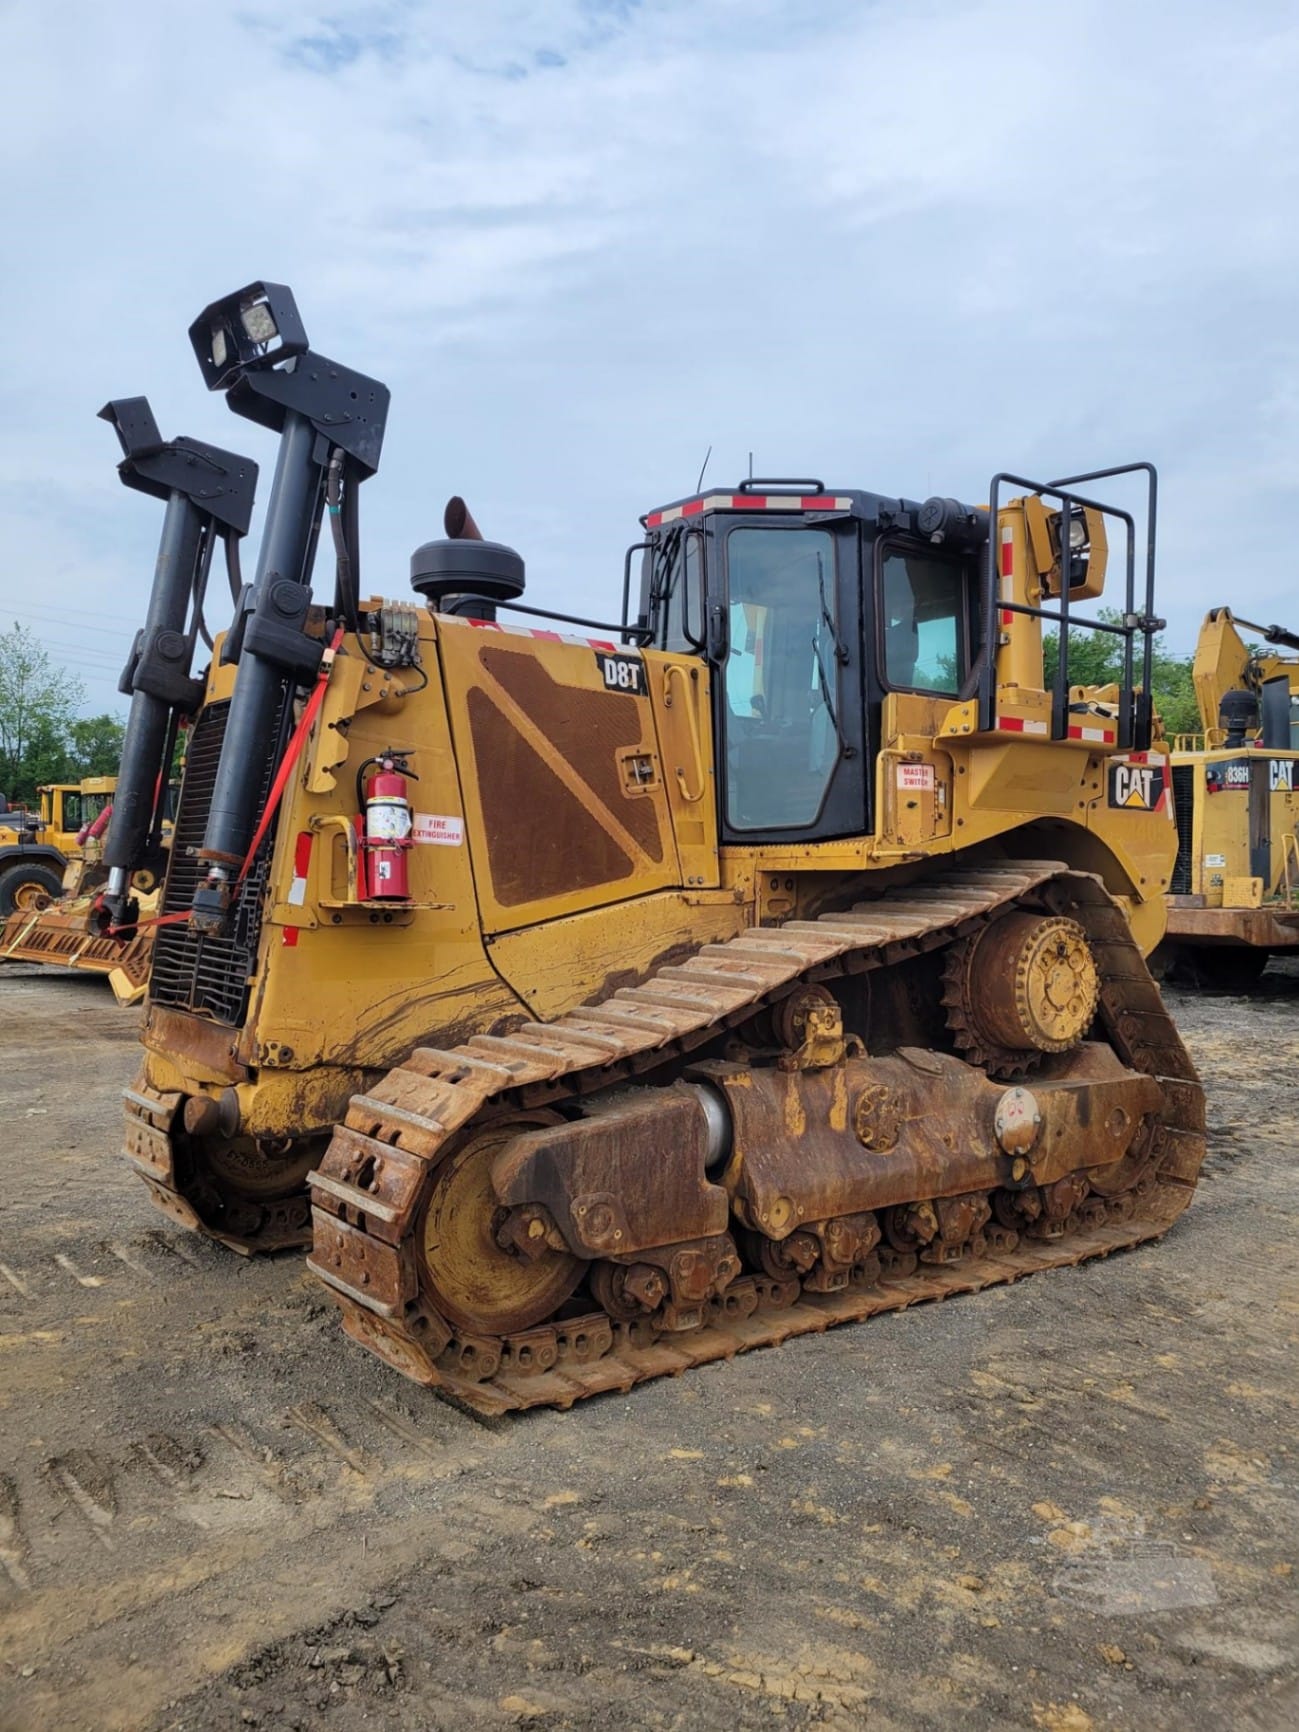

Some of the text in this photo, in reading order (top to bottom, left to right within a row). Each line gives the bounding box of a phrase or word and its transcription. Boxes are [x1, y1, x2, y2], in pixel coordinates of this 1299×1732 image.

[604, 658, 640, 689] D8T
[1227, 766, 1249, 783] 836H
[1270, 760, 1294, 791] CAT
[1115, 766, 1153, 808] CAT
[413, 831, 460, 840] EXTINGUISHER
[428, 820, 447, 829] FIRE
